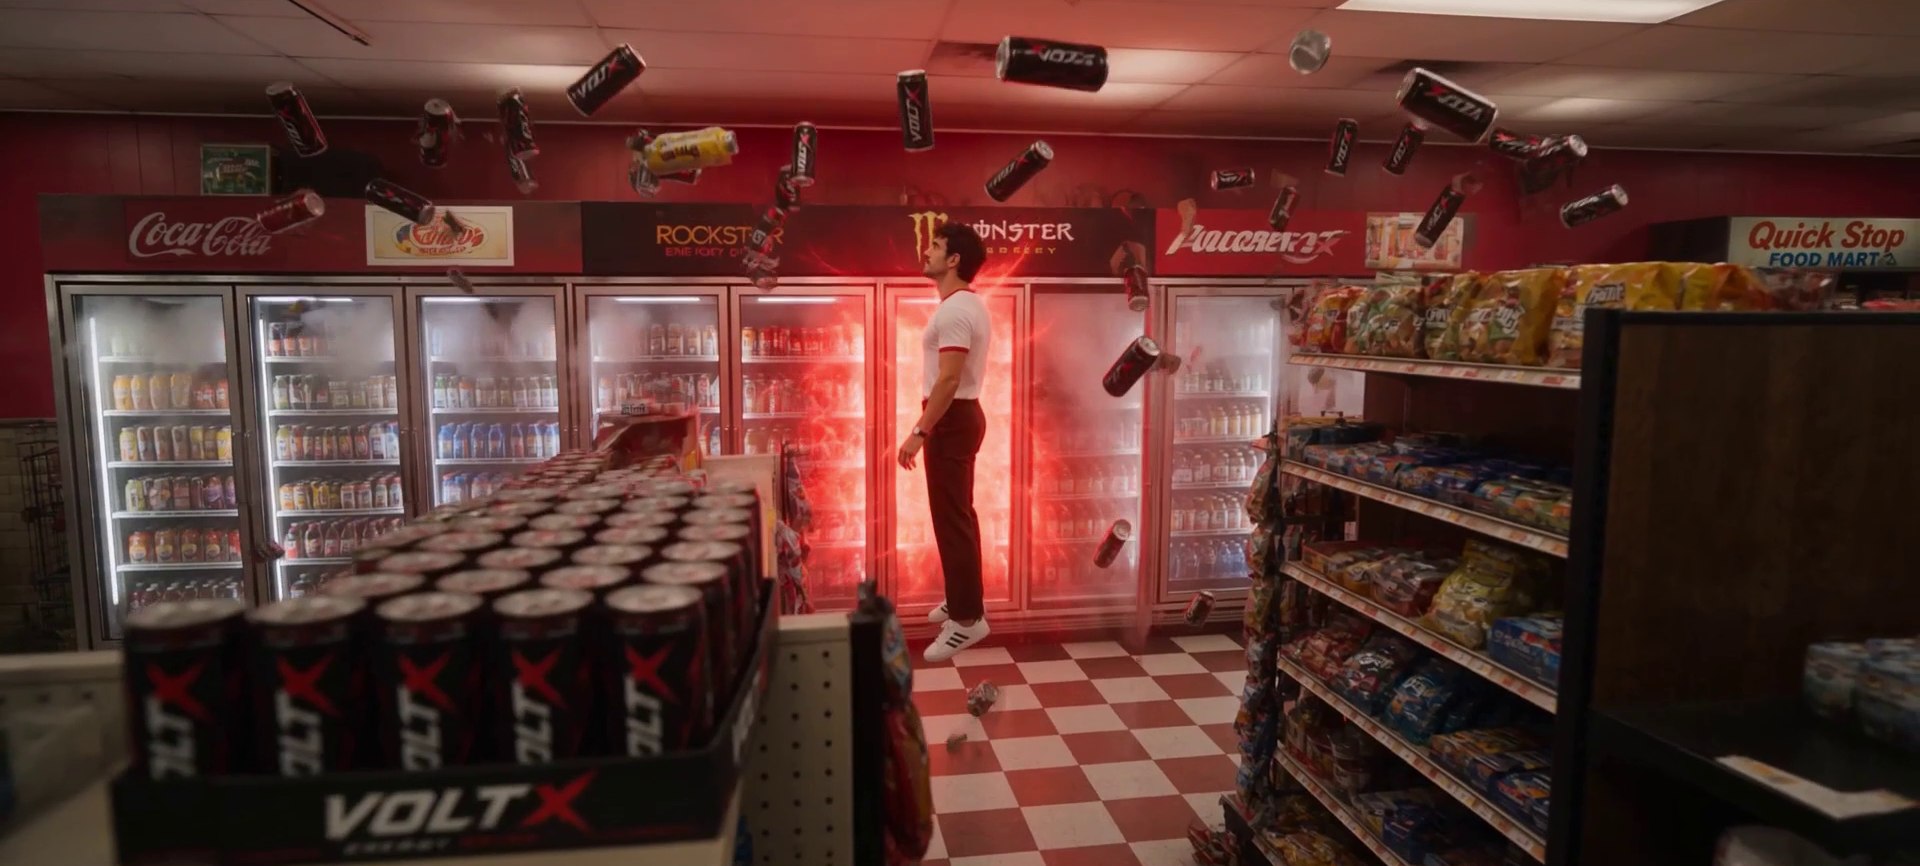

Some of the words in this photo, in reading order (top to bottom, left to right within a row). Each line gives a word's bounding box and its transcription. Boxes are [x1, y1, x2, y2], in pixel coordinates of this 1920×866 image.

[903, 85, 922, 141] VOLTX
[129, 212, 272, 257] Coca-Cola
[656, 225, 784, 245] ROCKSTR
[966, 219, 1074, 242] ONSTER
[1748, 220, 1836, 250] Quick
[1841, 220, 1905, 253] Stop
[1769, 252, 1821, 267] FOOD
[1827, 252, 1880, 267] MART
[145, 660, 211, 781] OLTX
[274, 653, 343, 777] OLTX
[397, 651, 456, 771] OLTX
[511, 646, 567, 766] OLTX
[623, 644, 675, 758] OLTX
